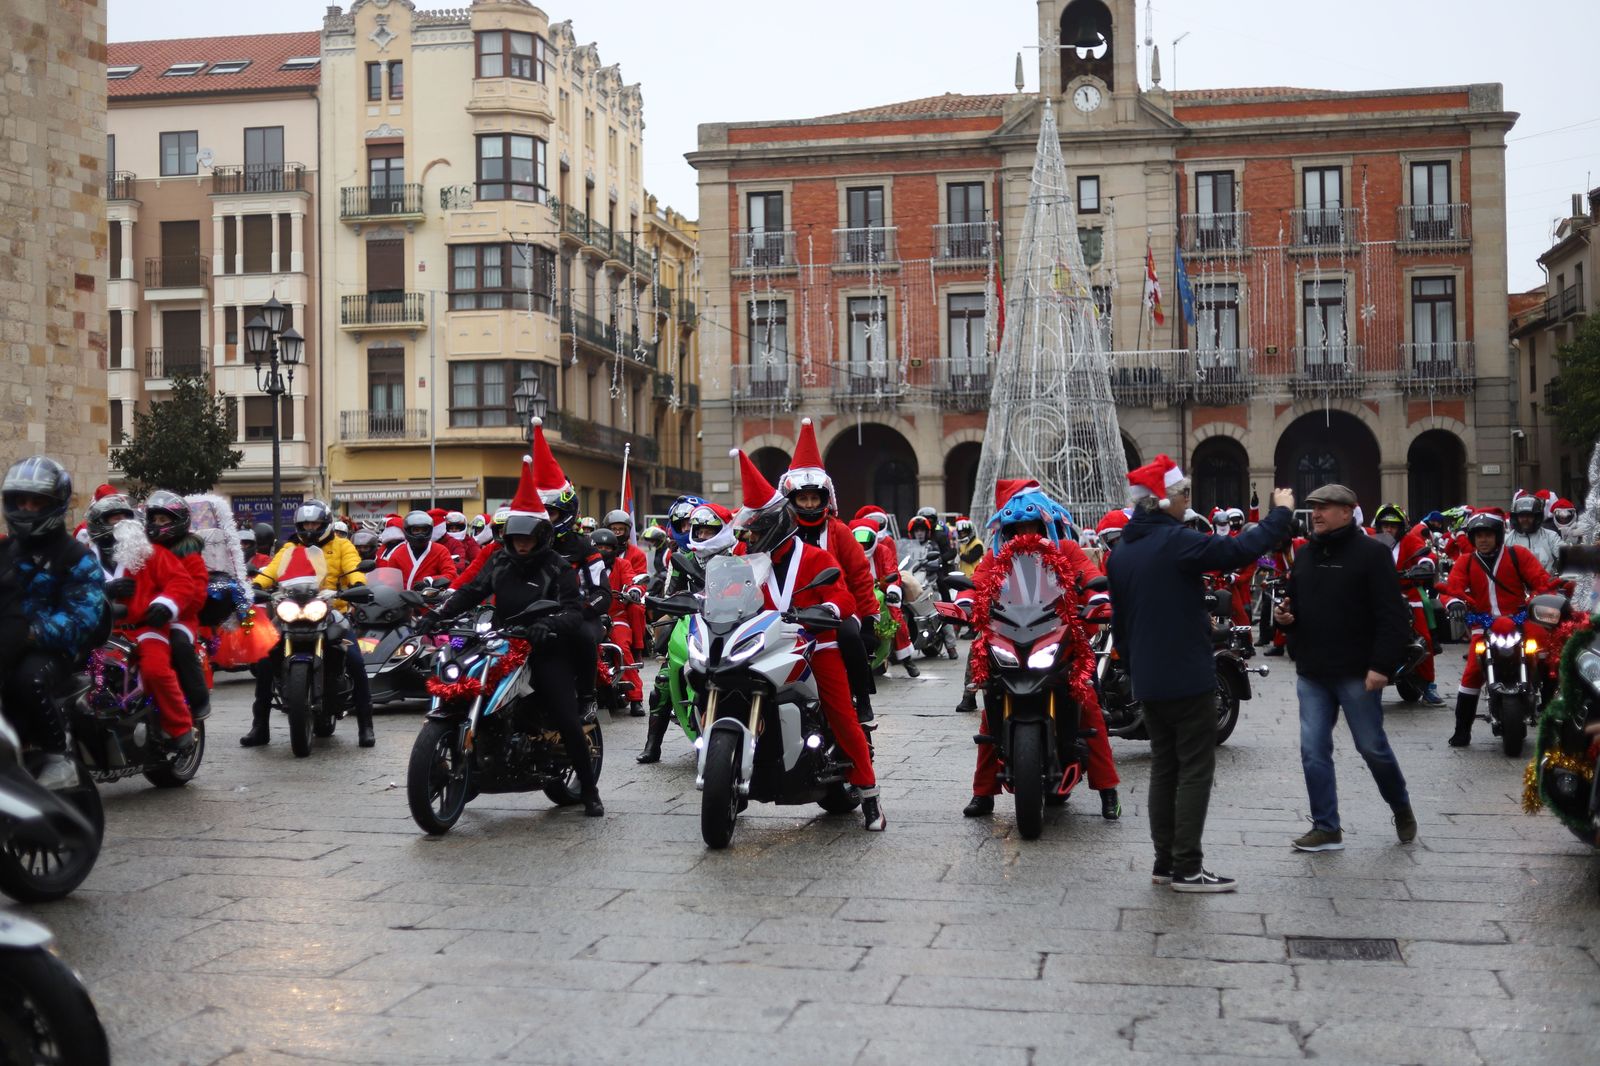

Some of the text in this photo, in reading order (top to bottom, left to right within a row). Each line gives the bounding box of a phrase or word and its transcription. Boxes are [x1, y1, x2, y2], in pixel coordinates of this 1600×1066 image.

[353, 491, 407, 500] RESTAURANTE
[410, 490, 436, 498] METR
[439, 489, 472, 497] ZAMORA
[238, 502, 299, 511] DR. CUAADO
